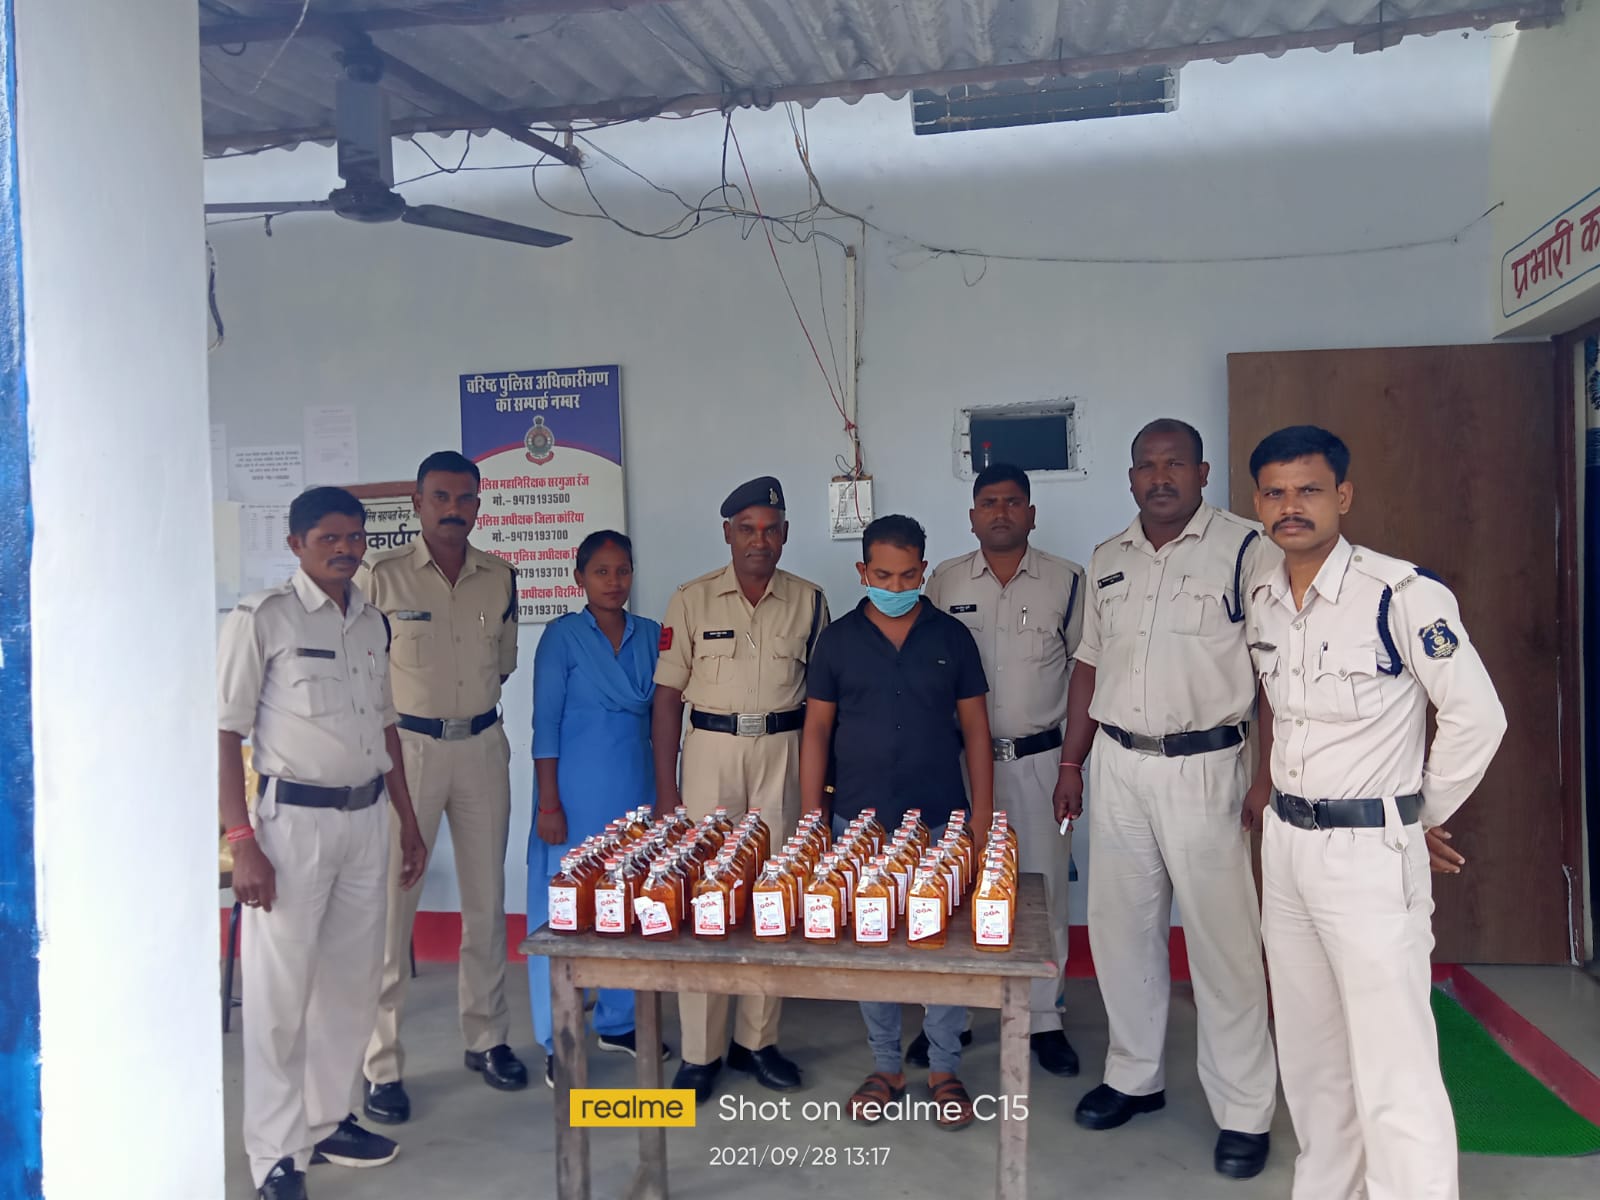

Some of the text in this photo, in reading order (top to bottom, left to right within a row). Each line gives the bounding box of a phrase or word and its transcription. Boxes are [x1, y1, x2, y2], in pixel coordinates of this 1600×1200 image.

[1511, 218, 1574, 299] प्रभारी
[466, 369, 609, 398] वरिष्ठ पुलिस अधिकारीगण
[495, 391, 581, 413] का सम्पर्क नम्बर
[477, 514, 500, 530] पुलिस
